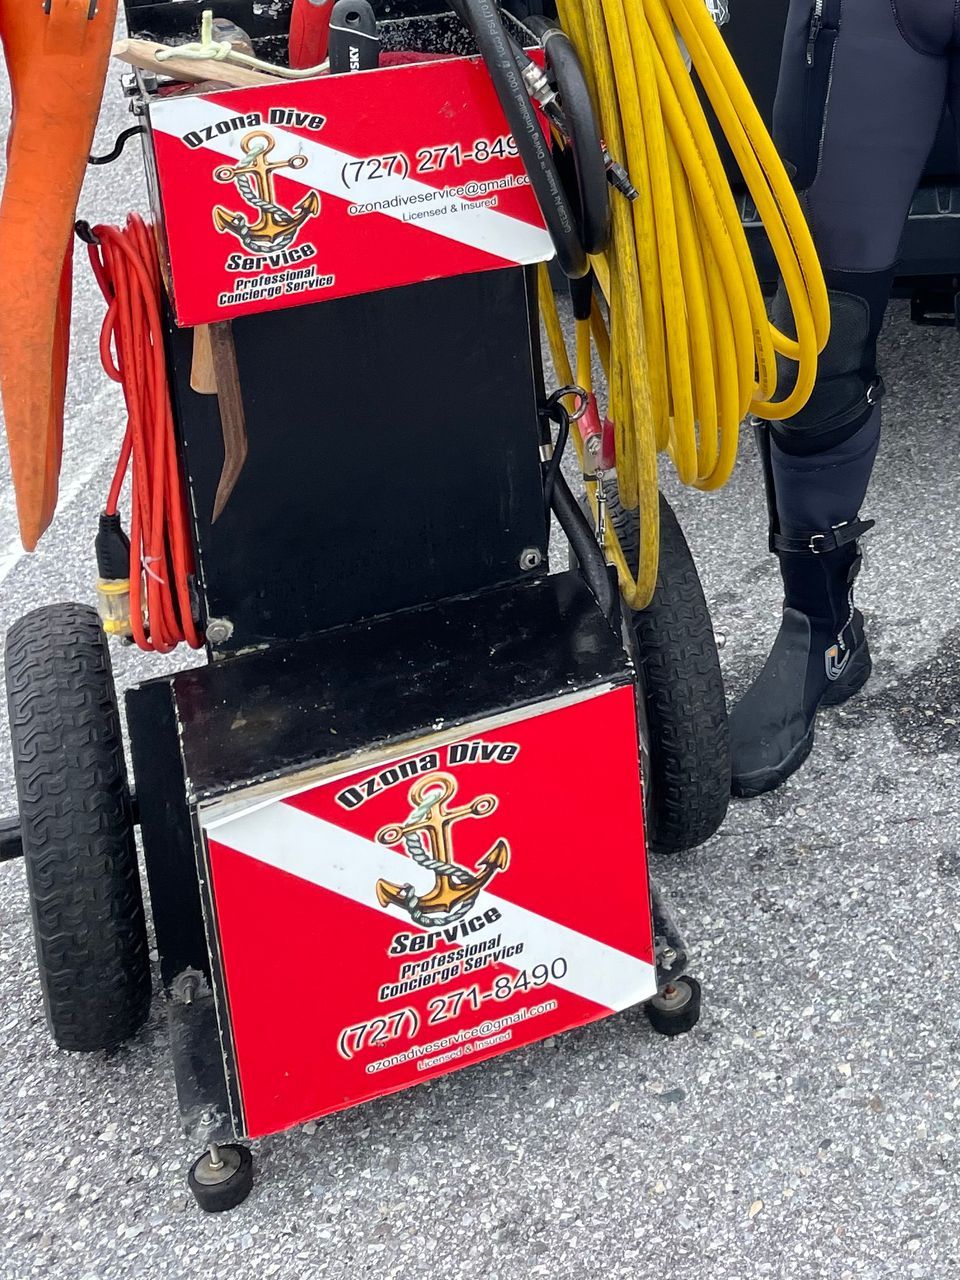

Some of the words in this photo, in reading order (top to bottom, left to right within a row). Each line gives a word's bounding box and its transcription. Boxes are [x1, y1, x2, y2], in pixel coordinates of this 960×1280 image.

[349, 46, 359, 72] SKY
[506, 70, 519, 92] 1000
[181, 111, 262, 149] Ozona
[269, 108, 325, 131] Dive
[514, 93, 535, 132] Umbilical
[340, 153, 410, 189] (727)
[418, 133, 519, 173] 271-849
[529, 132, 546, 159] Diving
[348, 173, 531, 216] ozonadiveservice@gmail.co
[402, 205, 447, 222] Licensed
[449, 202, 458, 213] &
[460, 196, 497, 212] Insured
[226, 244, 316, 272] Service
[218, 285, 283, 307] Concierge
[285, 275, 334, 294] Service
[234, 266, 316, 291] Professional
[336, 753, 439, 809] Ozona
[449, 741, 519, 765] Dive
[389, 906, 502, 956] Service
[378, 964, 460, 1001] Concierge
[464, 942, 524, 975] Service
[399, 934, 501, 980] Professional
[339, 1008, 419, 1058] (727)
[429, 957, 568, 1024] 271-8490
[366, 1000, 557, 1074] ozonadiveservice@gmail.com
[418, 1045, 463, 1071] Licensed
[464, 1044, 474, 1055] &
[475, 1031, 512, 1051] Insured
